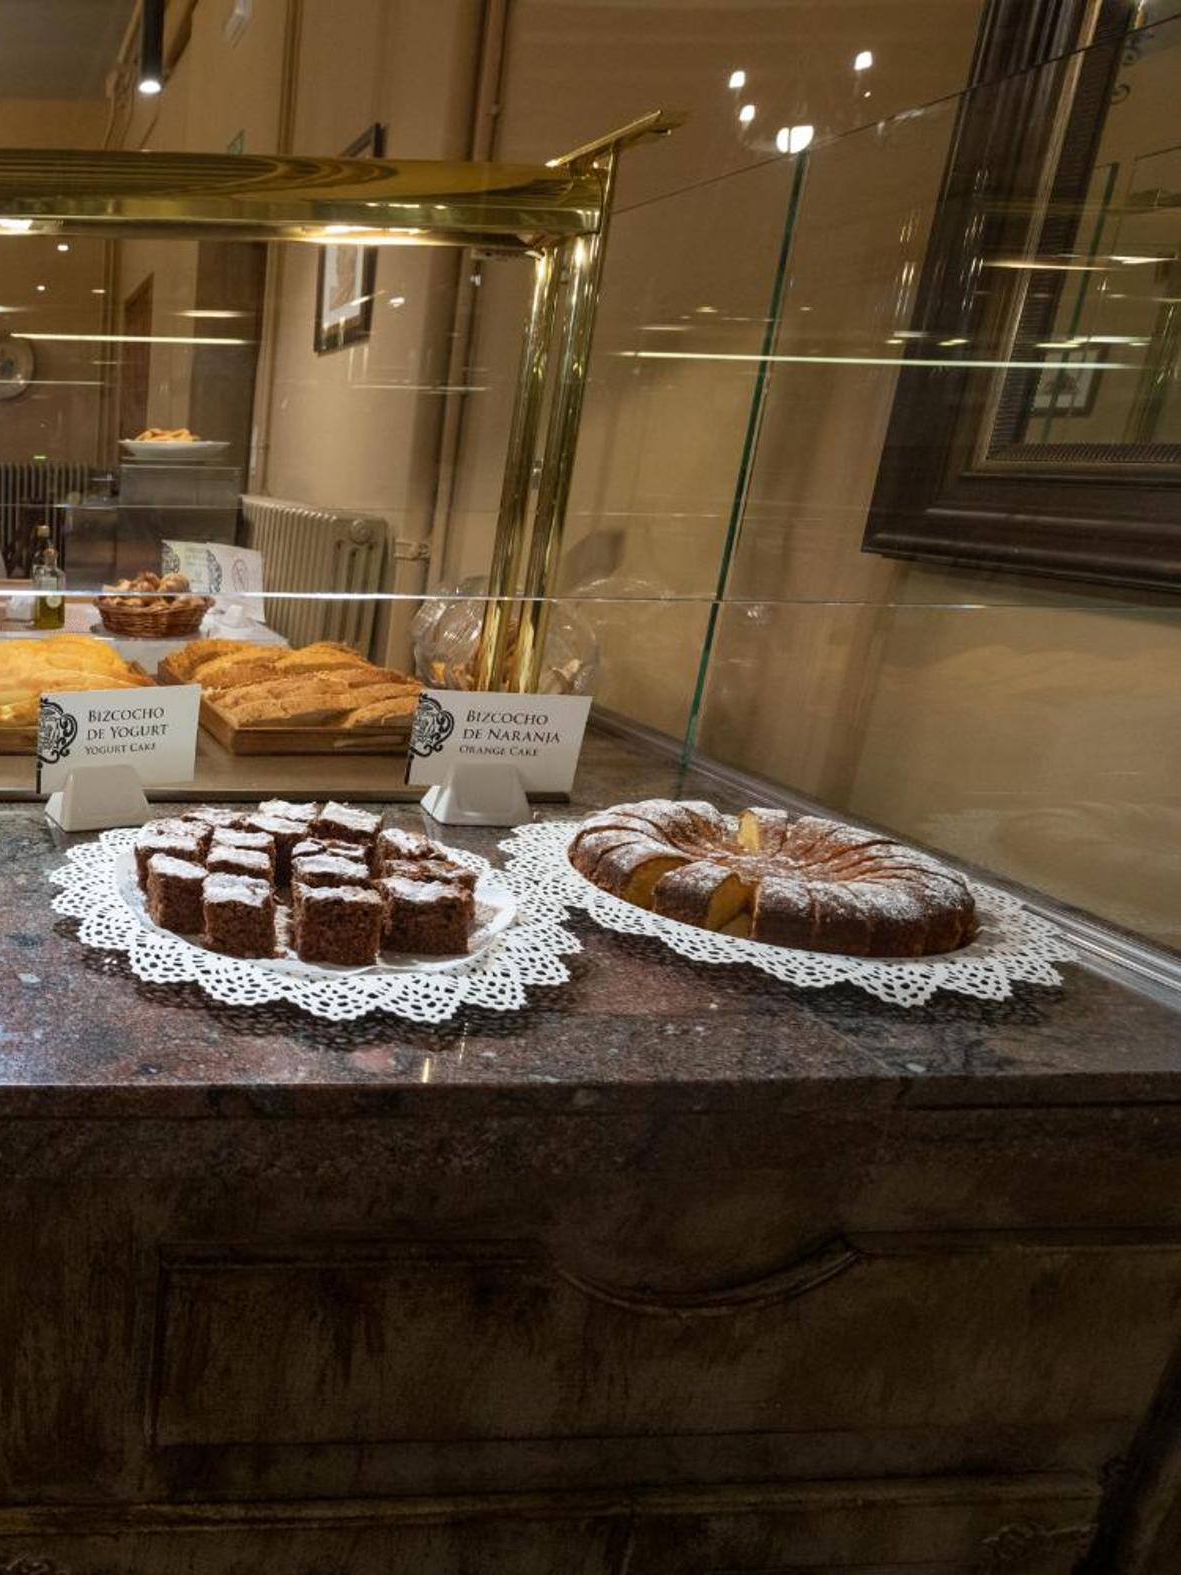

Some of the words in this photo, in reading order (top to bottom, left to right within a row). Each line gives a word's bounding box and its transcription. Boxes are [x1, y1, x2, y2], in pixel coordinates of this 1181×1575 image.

[88, 707, 165, 723] BIZCOCHO
[466, 710, 548, 726] BIZCOCHO
[87, 728, 105, 741] DE
[109, 723, 168, 739] YOGURT
[463, 728, 483, 740] DE
[487, 728, 561, 744] NARANJA
[84, 744, 128, 756] YOGURT
[129, 743, 157, 753] CAKE
[459, 746, 506, 756] ORANGE
[508, 746, 539, 757] CAKE
